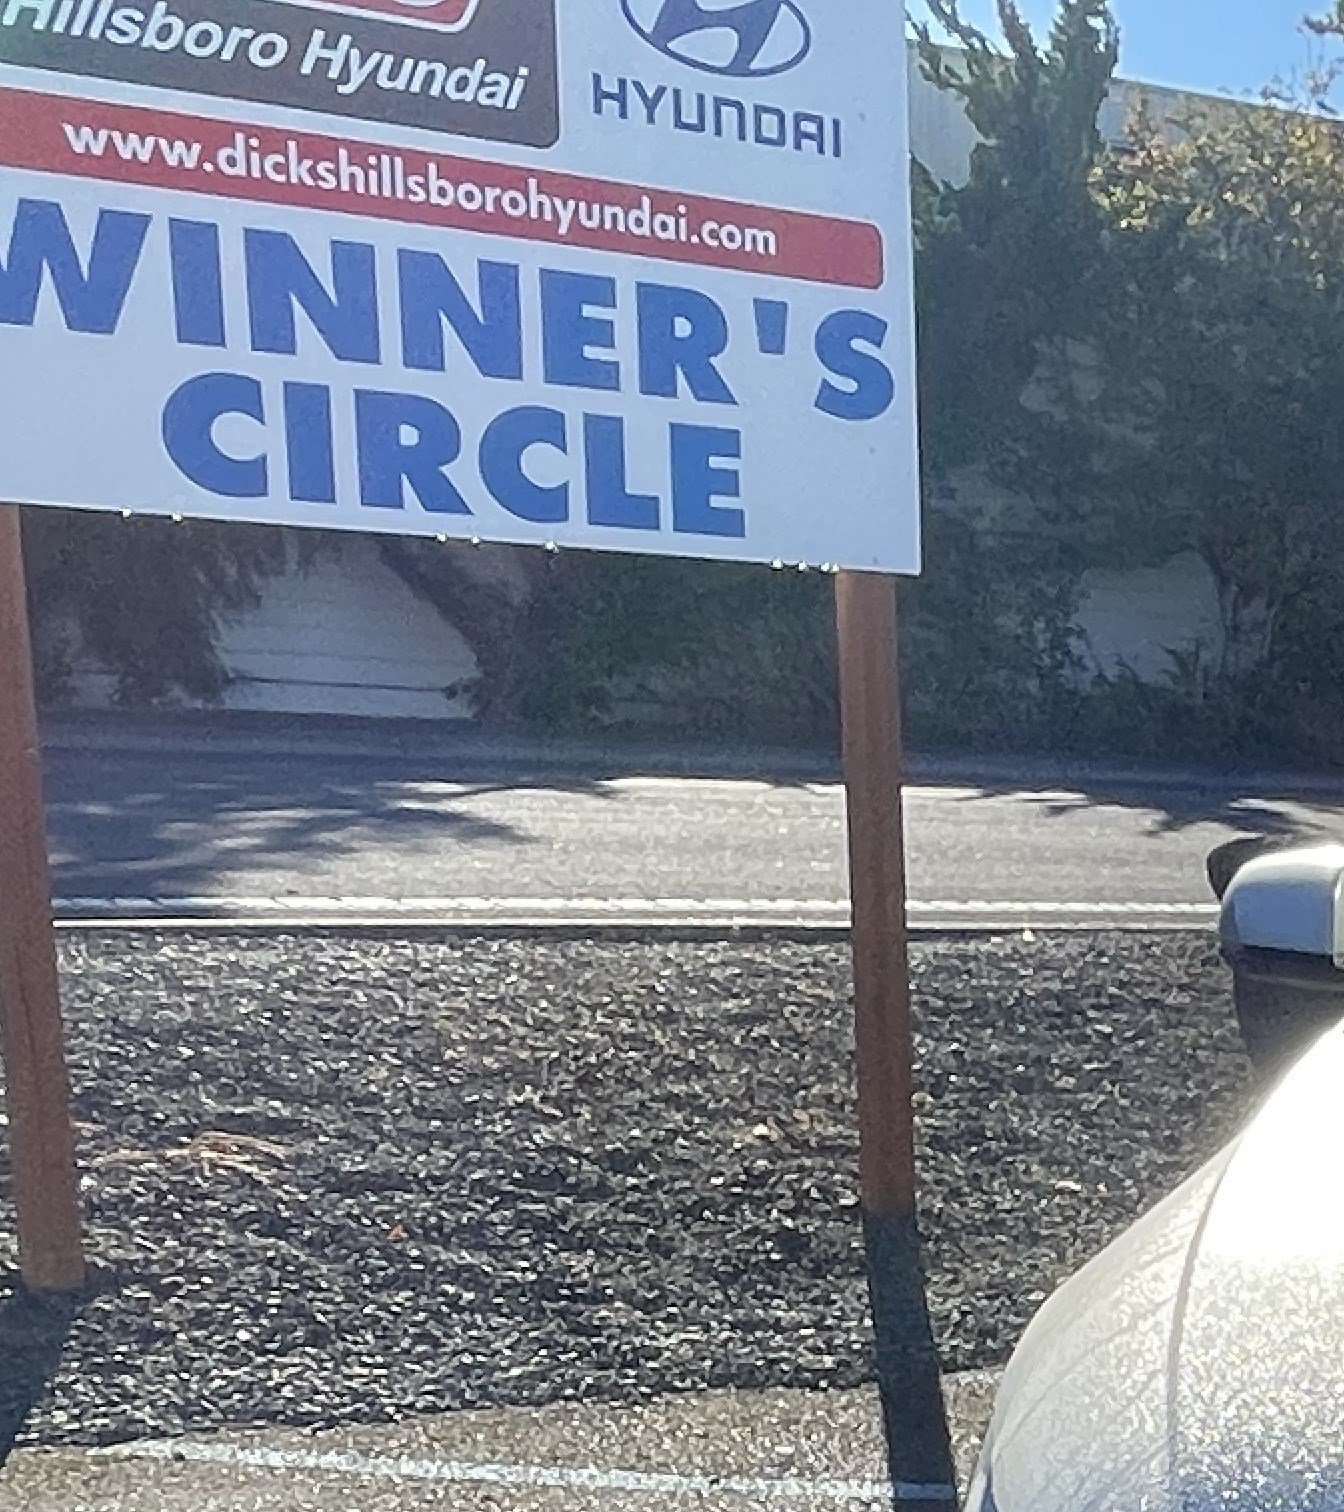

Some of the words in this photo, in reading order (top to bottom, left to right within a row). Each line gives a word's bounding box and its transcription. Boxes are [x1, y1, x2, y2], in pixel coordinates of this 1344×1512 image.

[2, 0, 289, 68] Hillsboro
[300, 28, 530, 110] Hyundai
[592, 72, 842, 157] HYUNDAI
[62, 122, 777, 256] www.dickshillsborohyundai.com
[0, 198, 894, 419] WINNER'S
[162, 371, 745, 537] CIRCLE
